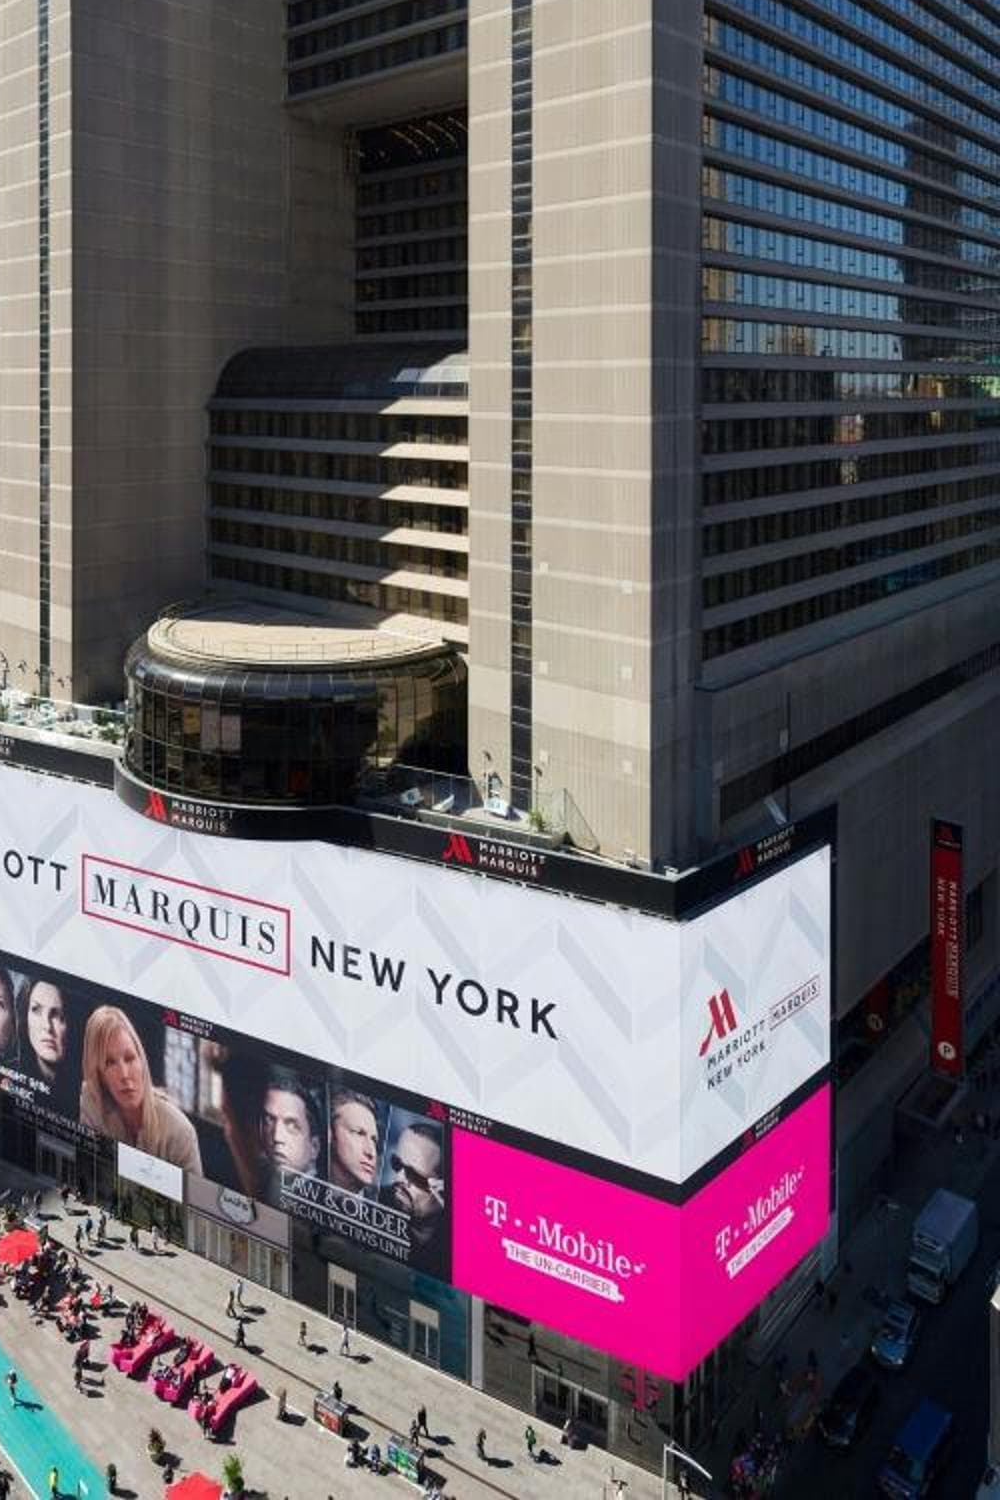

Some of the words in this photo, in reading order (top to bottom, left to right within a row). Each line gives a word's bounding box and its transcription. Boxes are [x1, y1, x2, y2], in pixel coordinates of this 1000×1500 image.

[171, 800, 235, 820] MARRIOTT
[171, 812, 227, 833] MARQUIS
[479, 841, 547, 865] MARRIOTT
[479, 854, 539, 877] MARQUIS
[92, 874, 278, 956] MARQUIS
[310, 935, 406, 993] NEW
[426, 967, 559, 1041] YORK
[707, 1019, 765, 1070] MARRIOTT
[707, 1063, 733, 1091] NEW
[737, 1041, 766, 1068] YORK
[281, 1171, 321, 1200] LAW
[325, 1190, 339, 1211] &
[341, 1197, 410, 1241] ORDER
[509, 1243, 532, 1264] THE
[534, 1252, 612, 1296] UN-CARRIER
